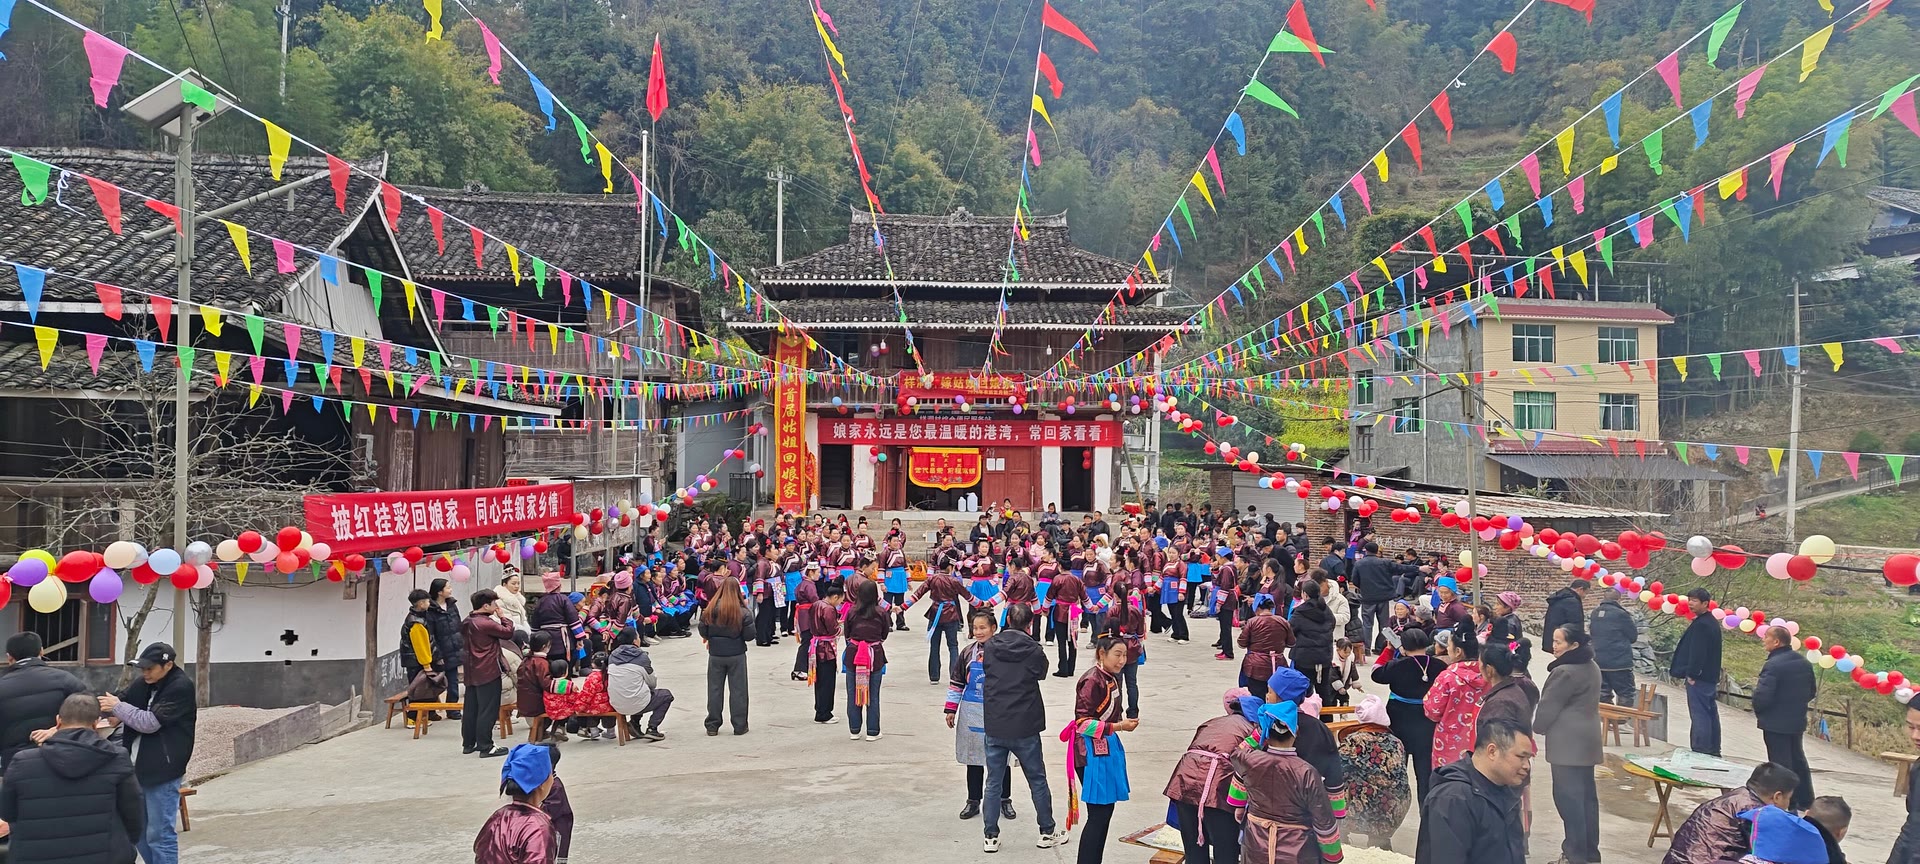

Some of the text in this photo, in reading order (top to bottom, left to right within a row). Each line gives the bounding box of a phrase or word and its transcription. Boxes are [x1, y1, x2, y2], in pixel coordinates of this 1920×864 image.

[904, 375, 1014, 389] 样嫁姑回娘家
[833, 422, 1108, 441] 娘家永远是您最温暖的港湾，常回家看看！
[331, 491, 563, 541] 披红挂彩回娘家，同心共叙家乡情！
